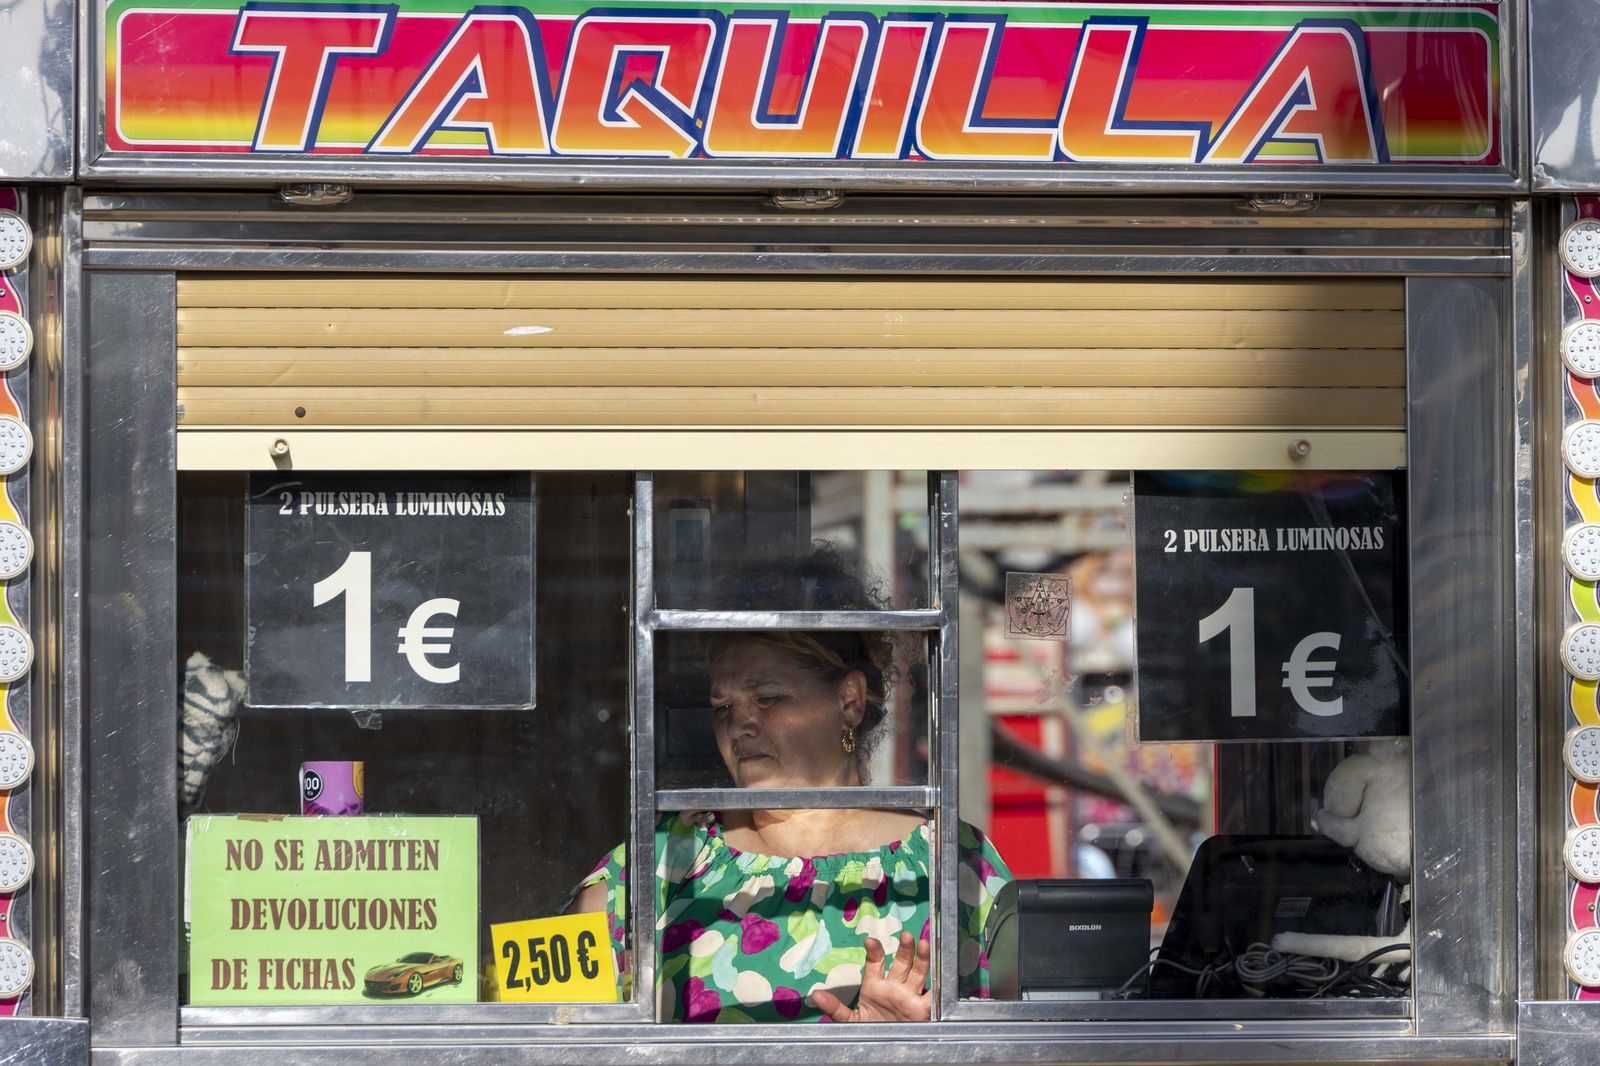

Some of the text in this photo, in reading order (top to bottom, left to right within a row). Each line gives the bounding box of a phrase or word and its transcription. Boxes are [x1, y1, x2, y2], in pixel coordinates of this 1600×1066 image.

[230, 2, 1389, 165] TAQUILLA
[279, 491, 506, 516] 2 PULSERA LUMINOSAS
[1164, 526, 1384, 553] 2 PULSERA LUMINOSAS
[313, 551, 460, 684] 1 €
[1199, 587, 1343, 717] 1 €
[225, 839, 440, 871] NO SE ADMITEN
[230, 898, 438, 930] DEVOLUCIONES
[211, 958, 356, 990] DE FICHAS
[502, 930, 599, 992] 2,50 €
